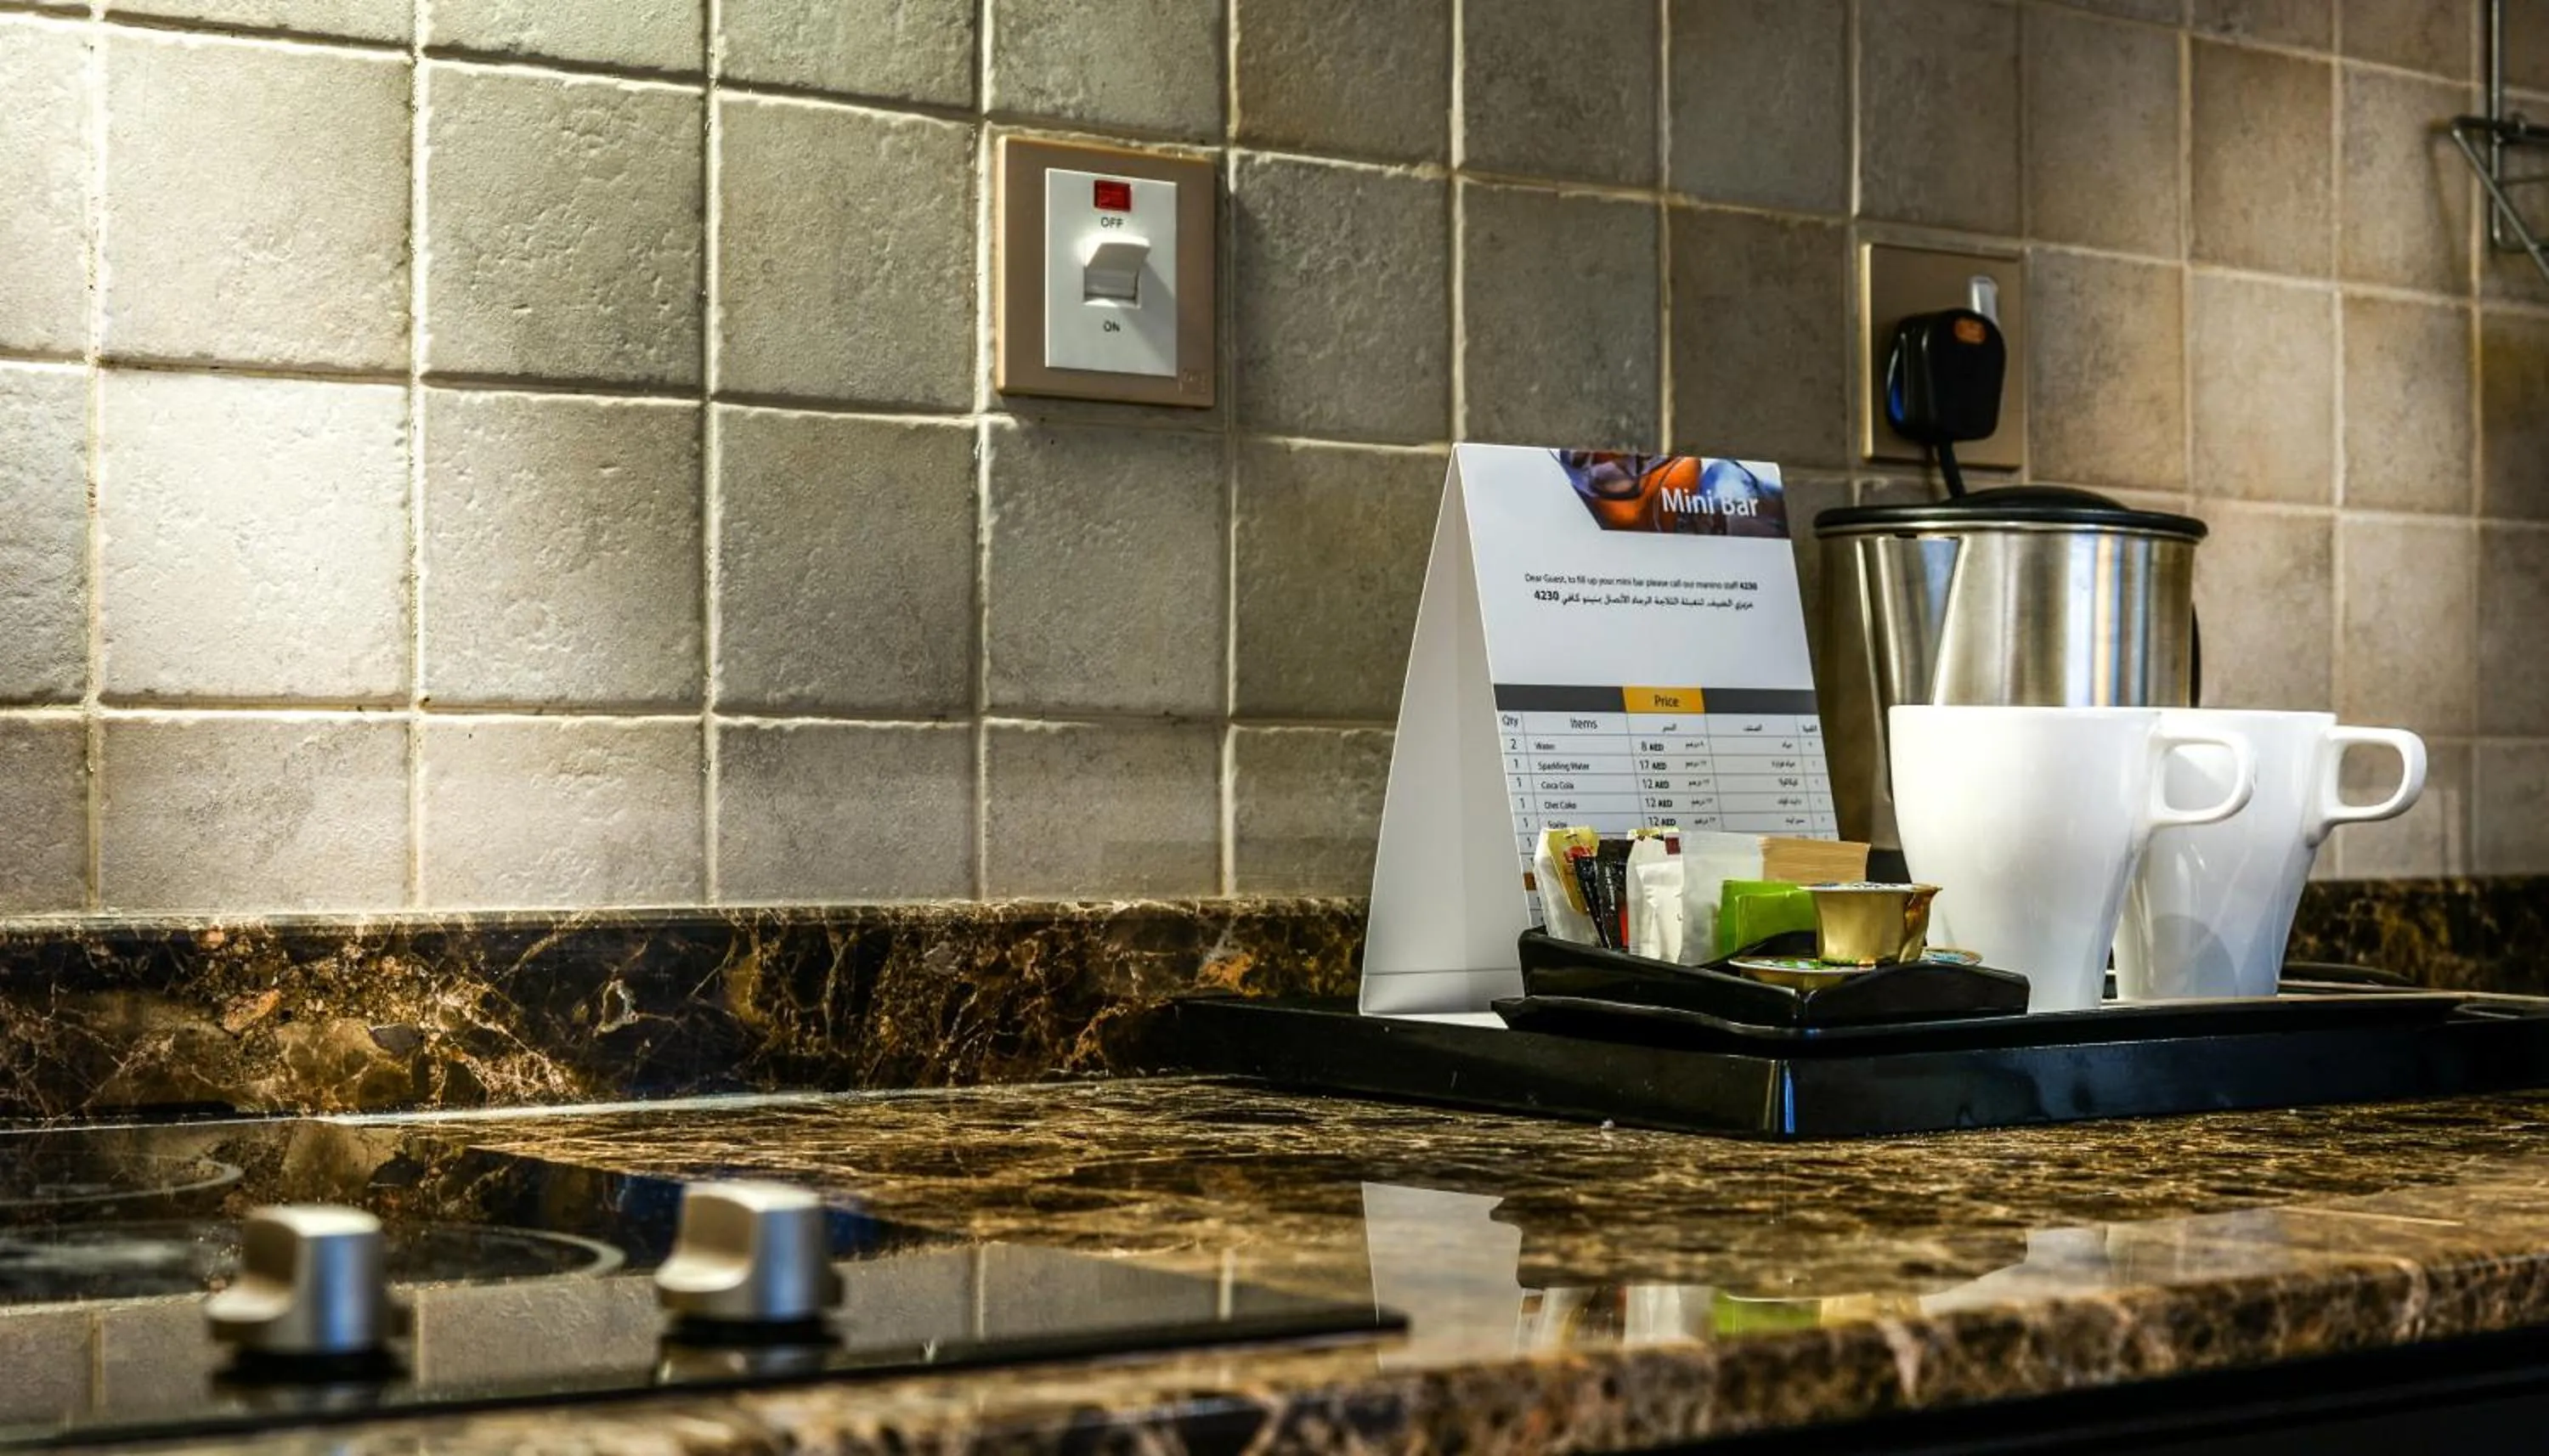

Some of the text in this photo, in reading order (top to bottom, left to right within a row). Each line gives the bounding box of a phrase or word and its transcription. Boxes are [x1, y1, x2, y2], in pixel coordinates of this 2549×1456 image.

[1100, 217, 1123, 229] OFF
[1103, 320, 1121, 332] ON
[1661, 487, 1759, 516] Mini Bar
[1525, 573, 1541, 582] Dear
[1599, 578, 1614, 586] your
[1633, 578, 1643, 586] bar
[1646, 579, 1667, 588] please
[1670, 579, 1681, 588] call
[1739, 582, 1757, 590] 4230
[1534, 590, 1559, 601] 4230
[1654, 695, 1679, 707] Price
[1502, 714, 1518, 726] Qty
[1570, 718, 1597, 729] Items
[1511, 738, 1517, 749] 2
[1642, 742, 1647, 751] 8
[1513, 759, 1518, 768] 1
[1517, 776, 1522, 787] 1
[1642, 779, 1652, 788] 12
[1520, 798, 1524, 809] 1
[1544, 801, 1558, 810] Diet
[1645, 798, 1656, 807] 12
[1523, 817, 1529, 827] 1
[1648, 816, 1659, 826] 12
